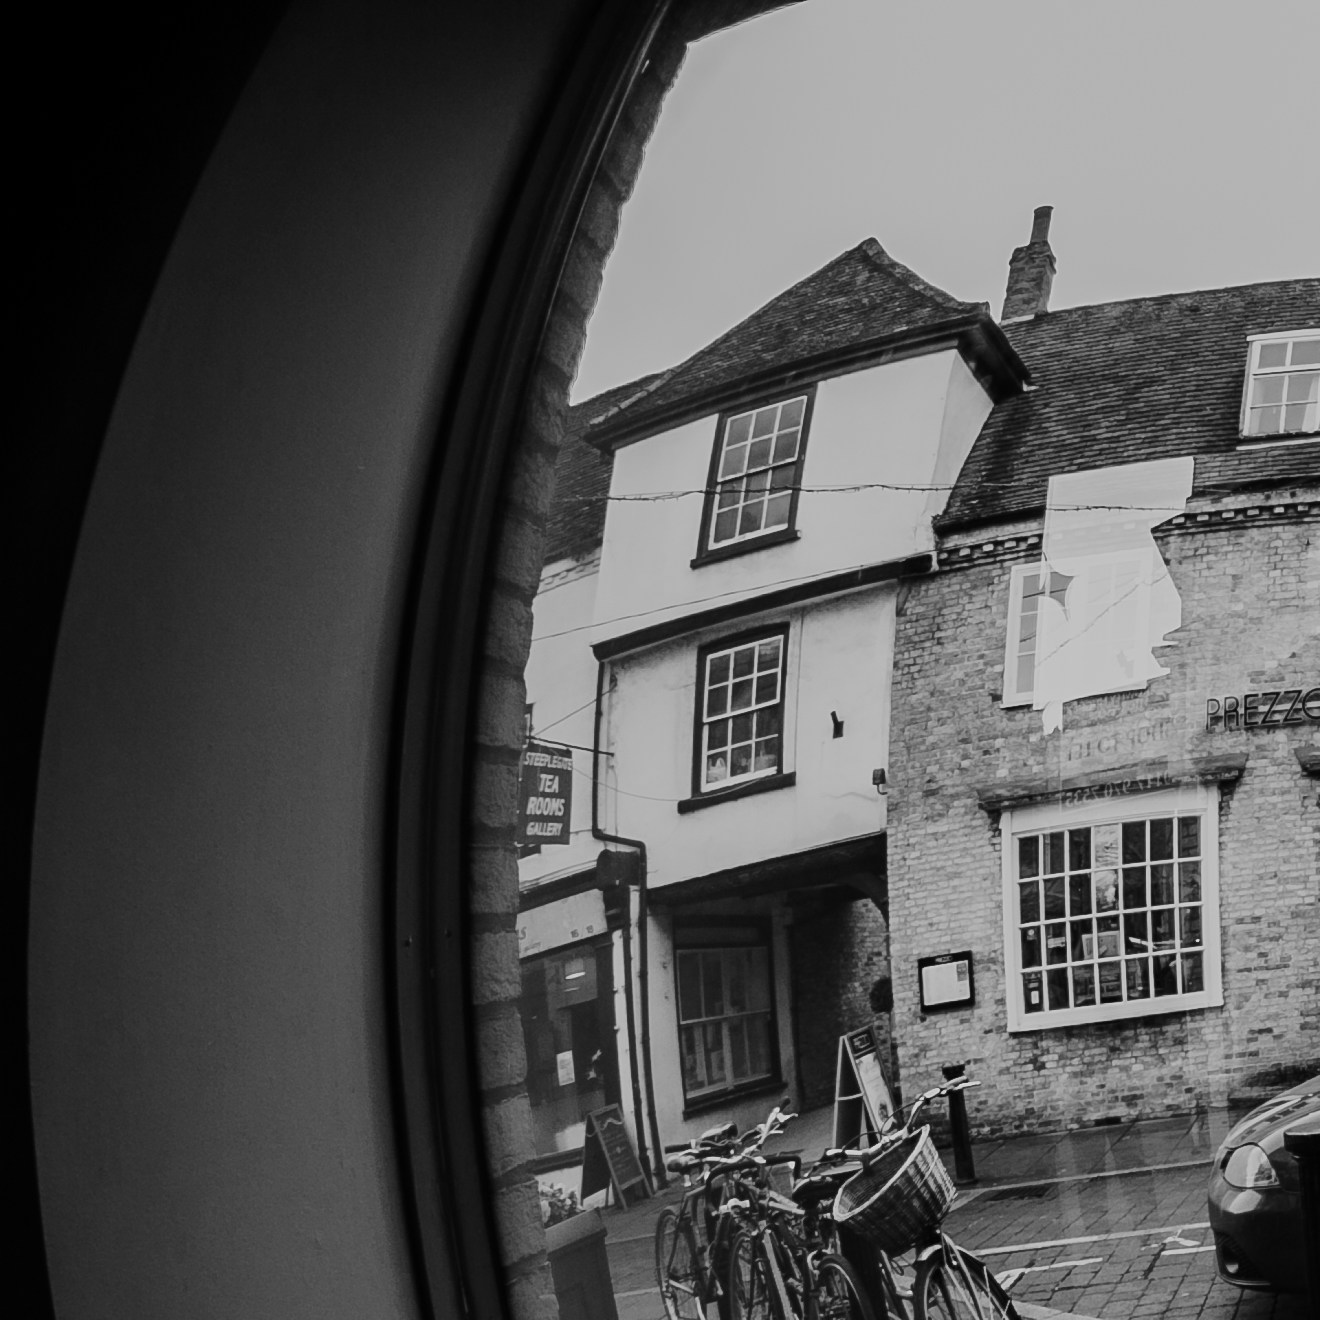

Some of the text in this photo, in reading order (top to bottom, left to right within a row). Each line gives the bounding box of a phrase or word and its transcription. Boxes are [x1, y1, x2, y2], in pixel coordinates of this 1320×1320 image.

[539, 773, 559, 794] TEA
[526, 796, 566, 817] ROOMS
[526, 821, 563, 837] GALLERY
